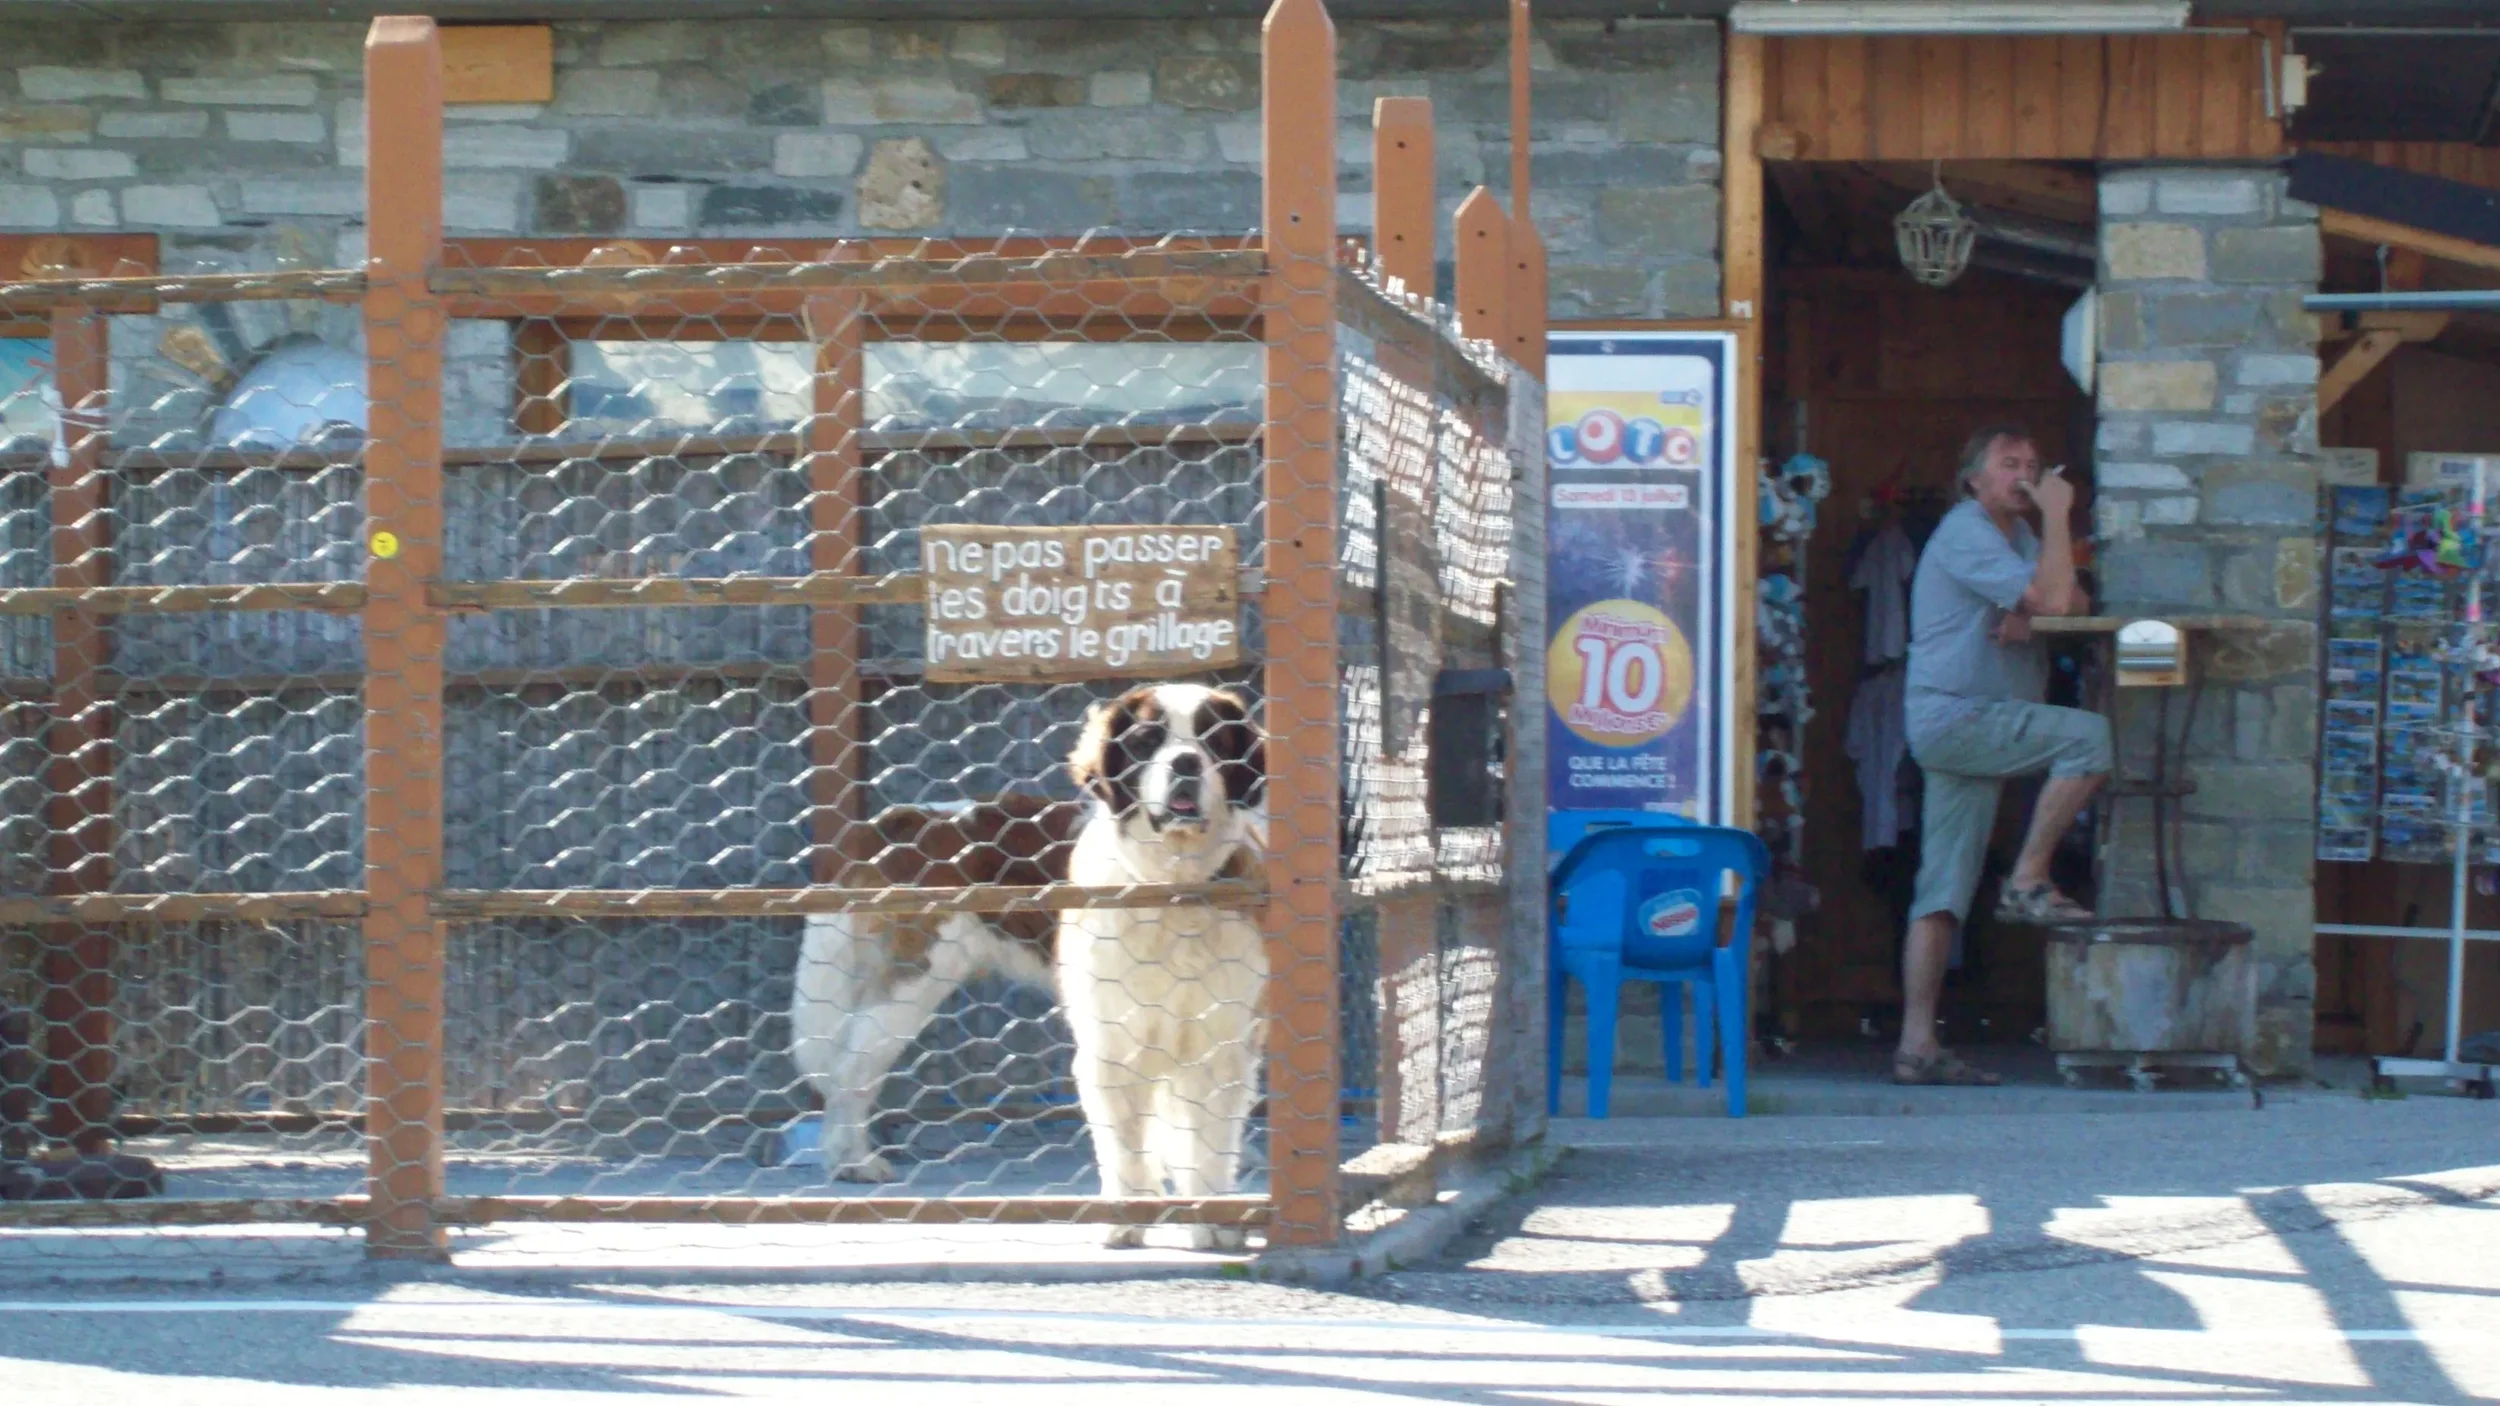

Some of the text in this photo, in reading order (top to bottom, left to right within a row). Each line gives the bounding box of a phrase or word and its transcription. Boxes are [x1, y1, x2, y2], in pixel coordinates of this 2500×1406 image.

[1547, 408, 1698, 465] LOTO
[926, 533, 1224, 582] ne pas passer
[928, 569, 1189, 625] les doigts à
[926, 612, 1235, 667] travers le grillage
[1574, 634, 1666, 717] 10
[1568, 756, 1604, 771] QUE
[1607, 756, 1629, 771] LA
